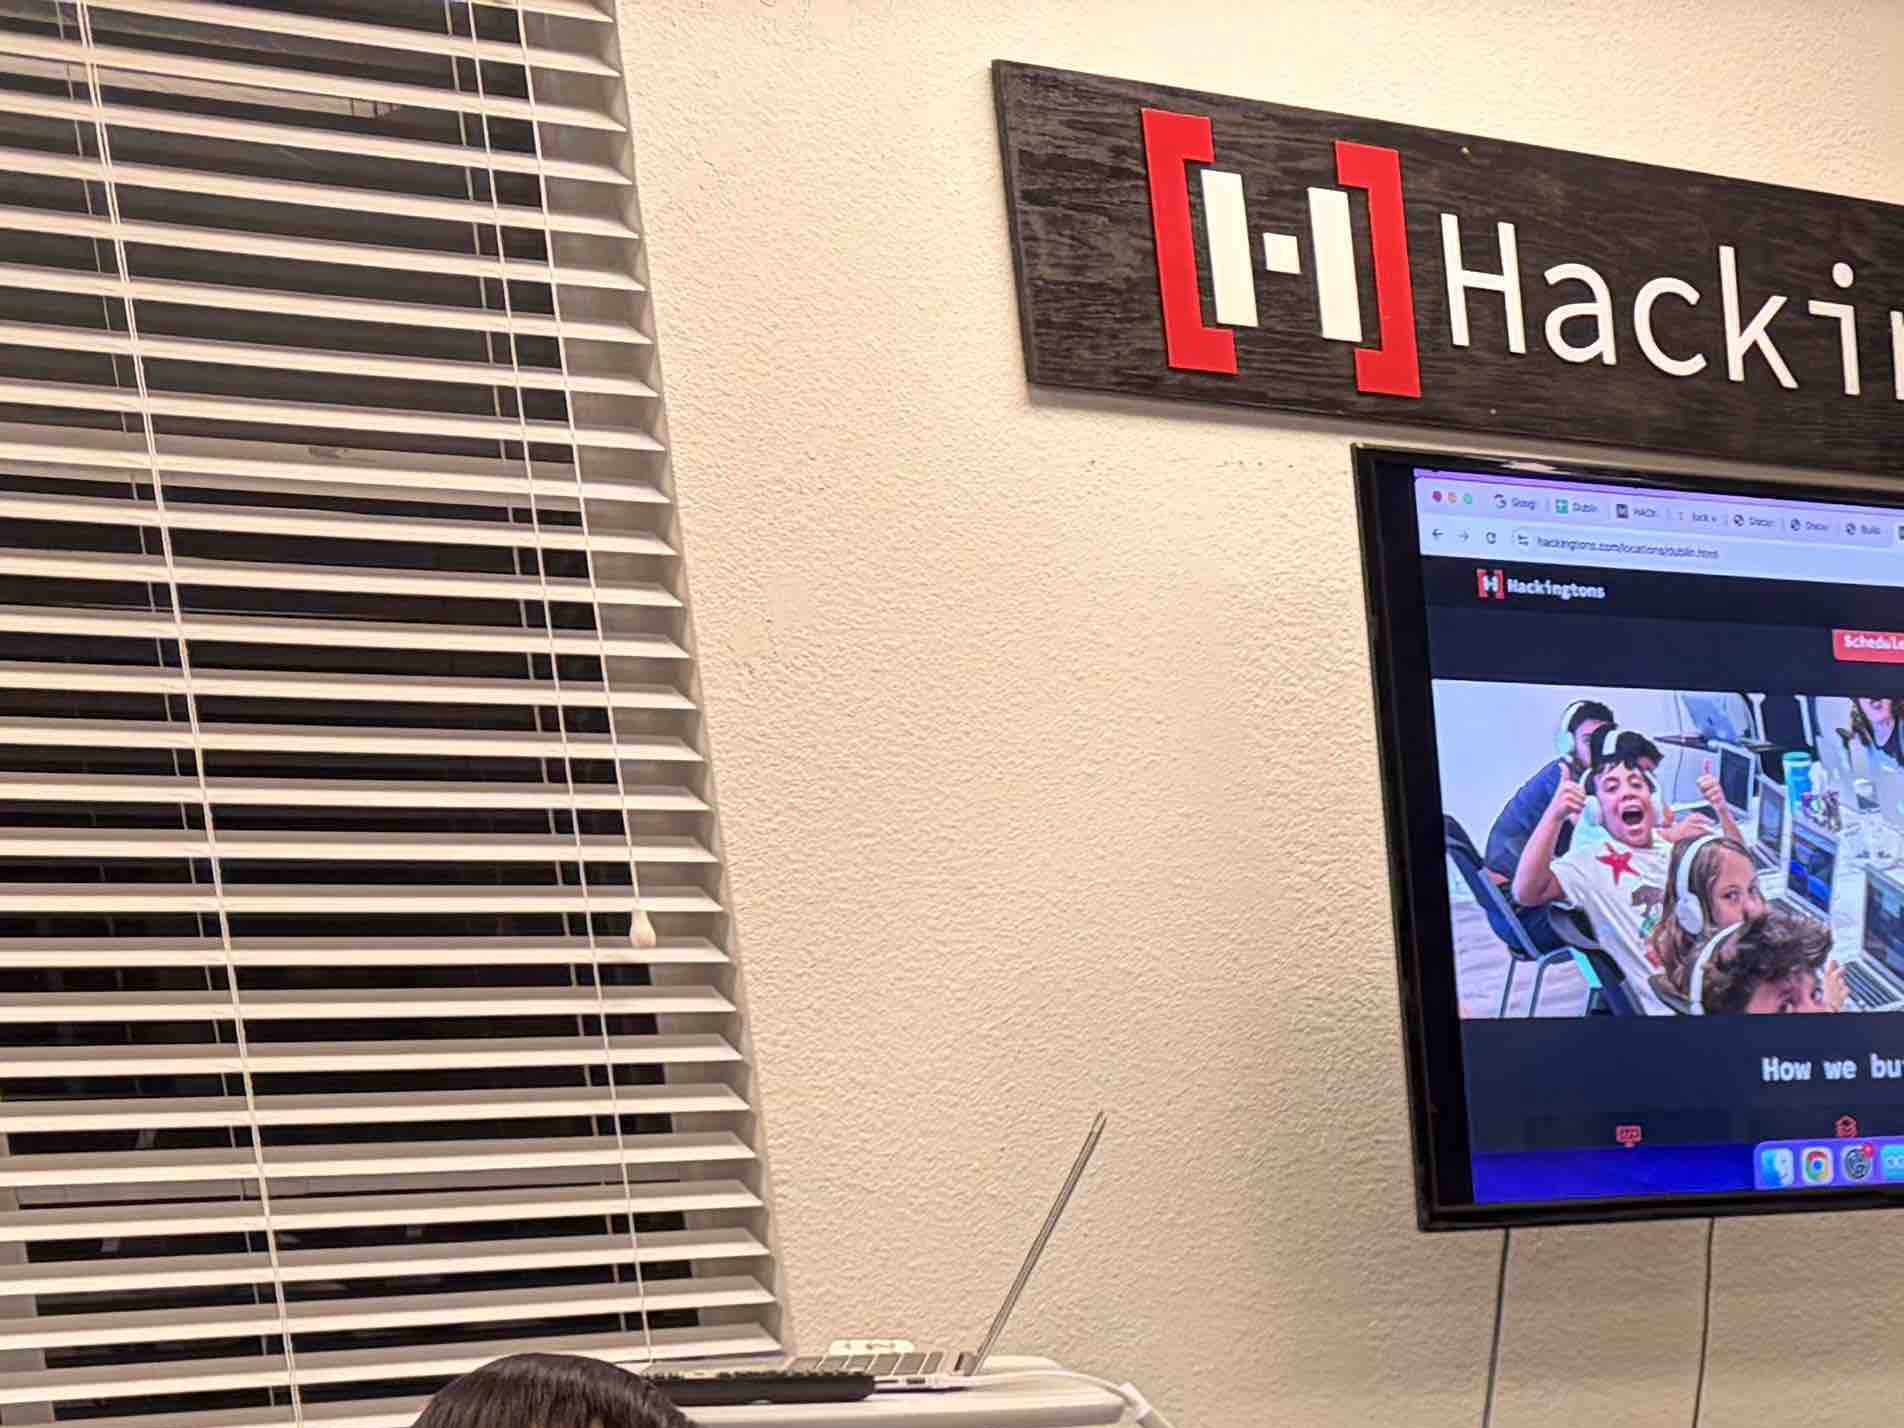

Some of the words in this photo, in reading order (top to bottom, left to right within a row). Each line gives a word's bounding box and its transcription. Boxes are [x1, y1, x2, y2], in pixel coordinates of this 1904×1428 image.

[1506, 577, 1606, 600] Hackingtons
[1761, 1056, 1812, 1081] How
[1823, 1059, 1857, 1080] we
